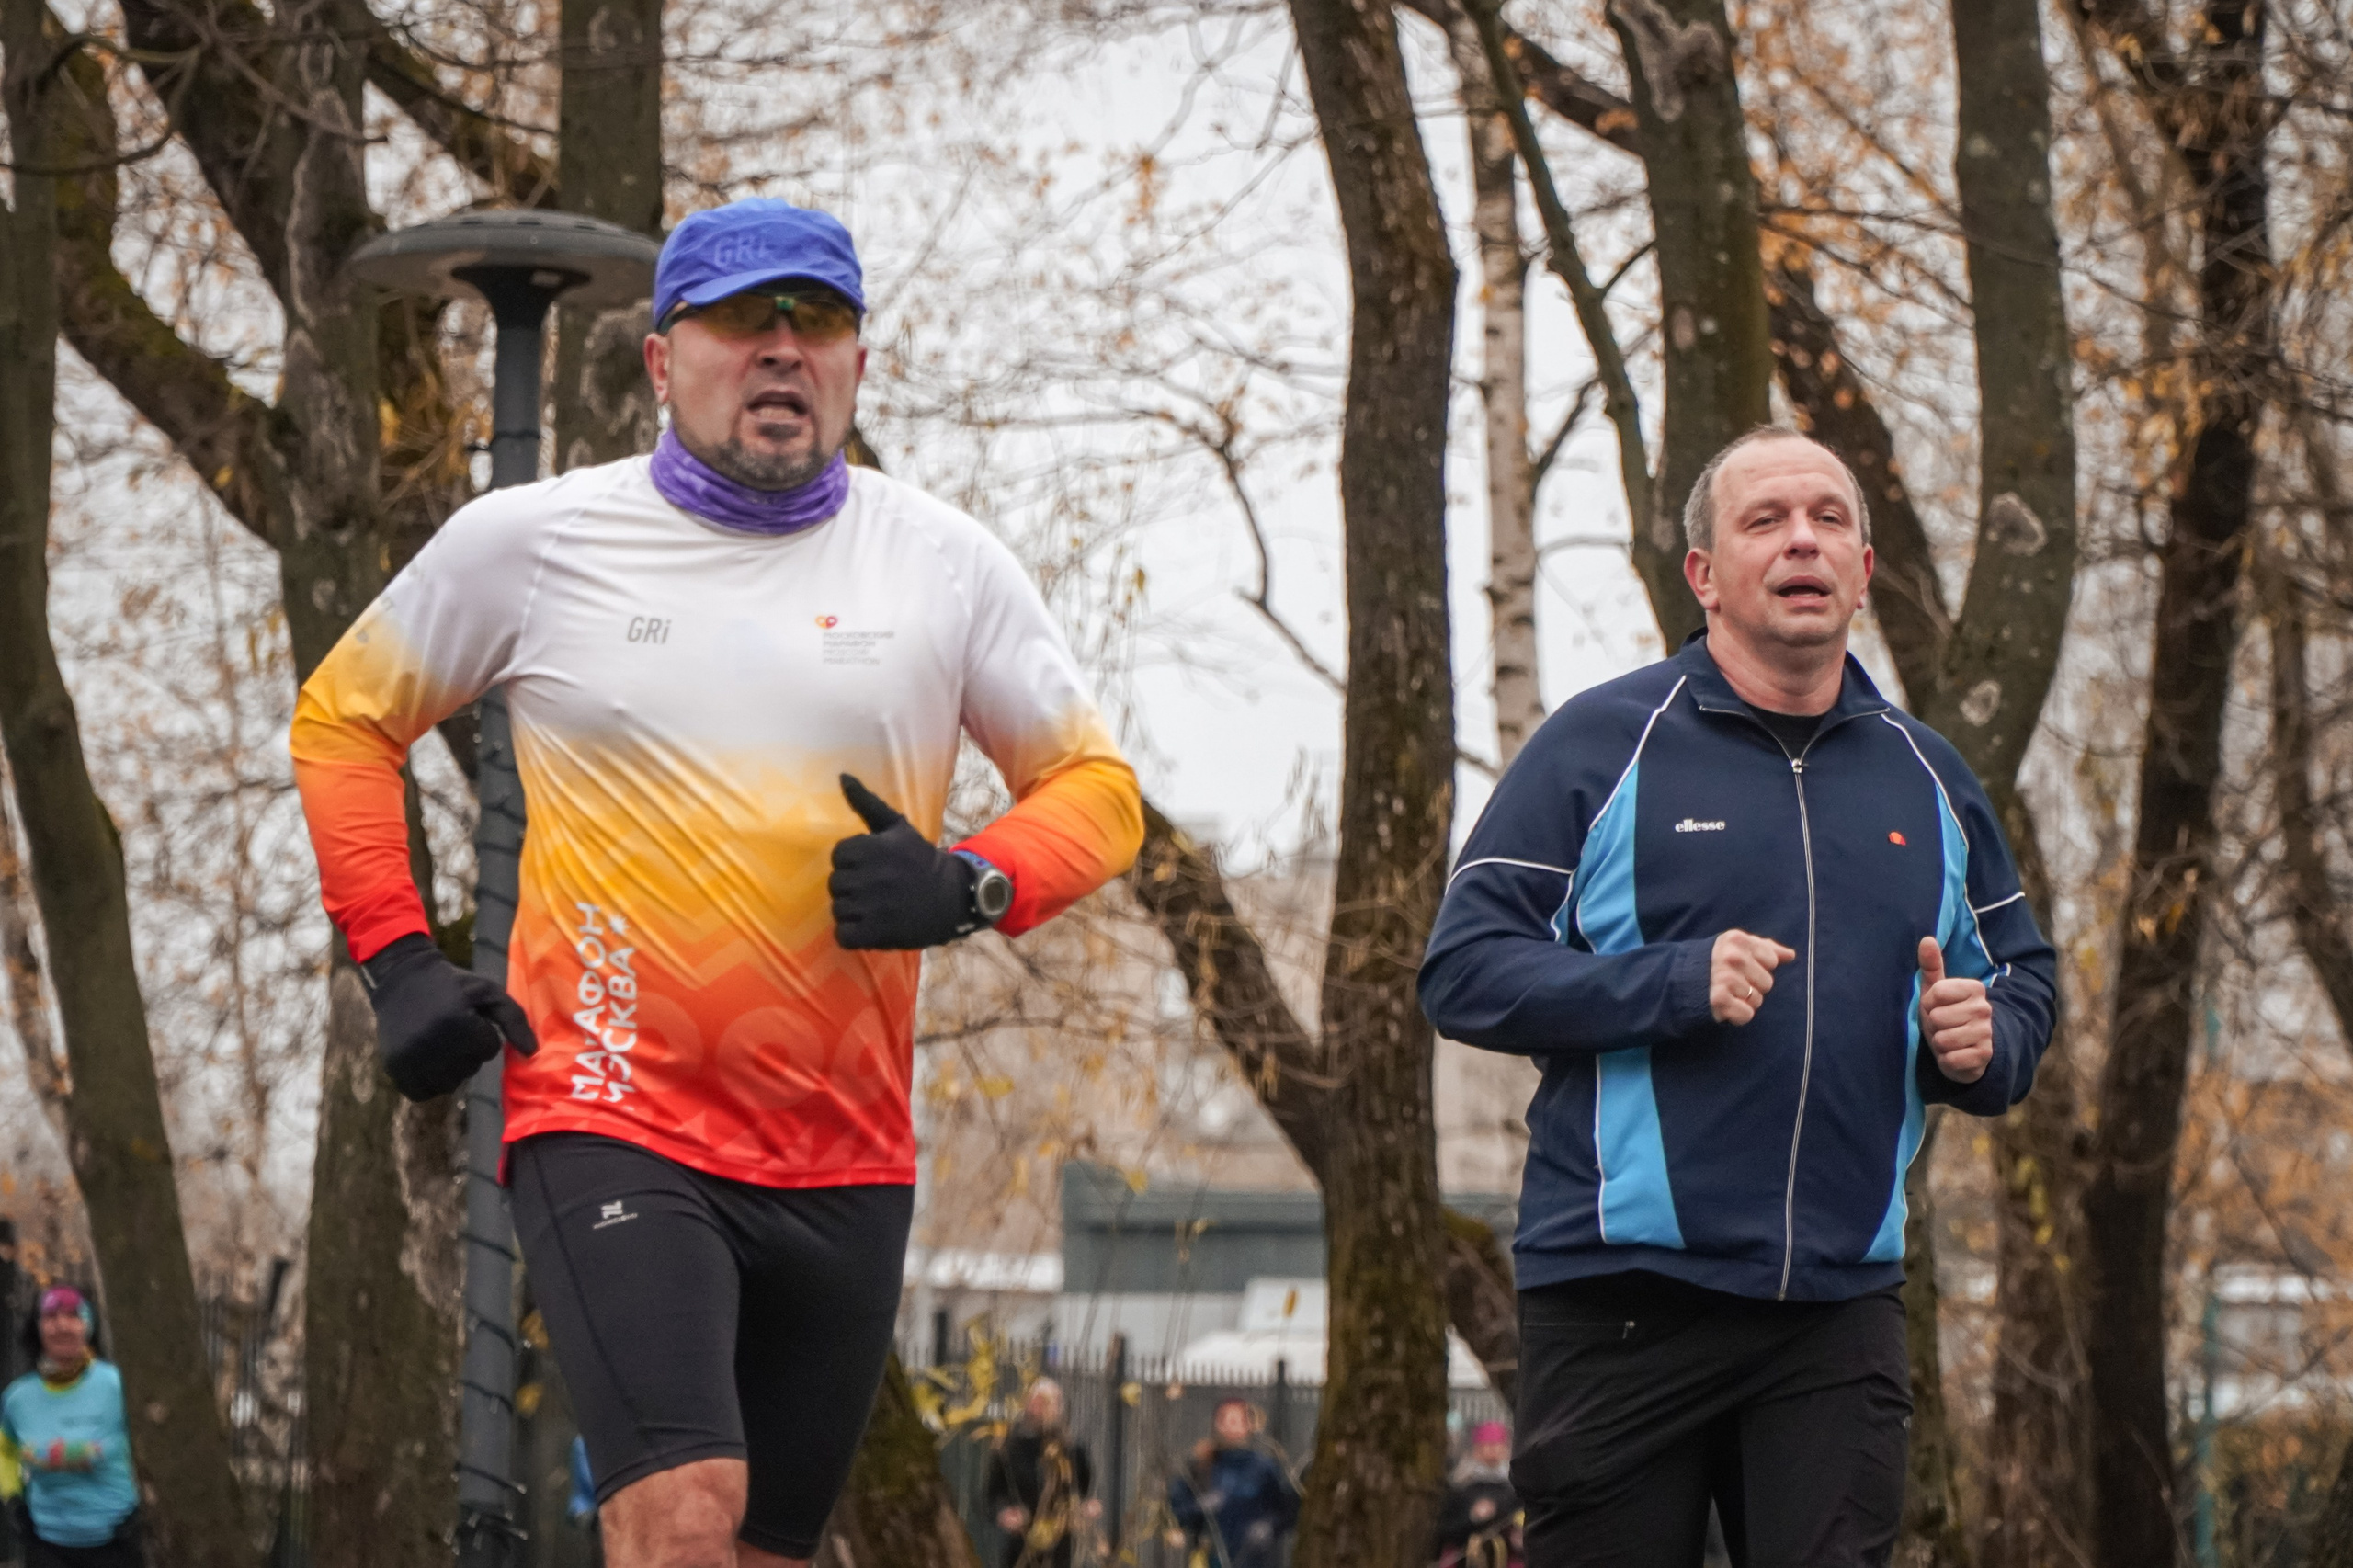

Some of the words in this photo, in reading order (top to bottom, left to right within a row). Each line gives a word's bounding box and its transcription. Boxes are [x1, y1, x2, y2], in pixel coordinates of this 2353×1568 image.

[627, 616, 672, 644] GRi
[1675, 818, 1725, 833] ellesse
[571, 902, 606, 1101] МААФОН
